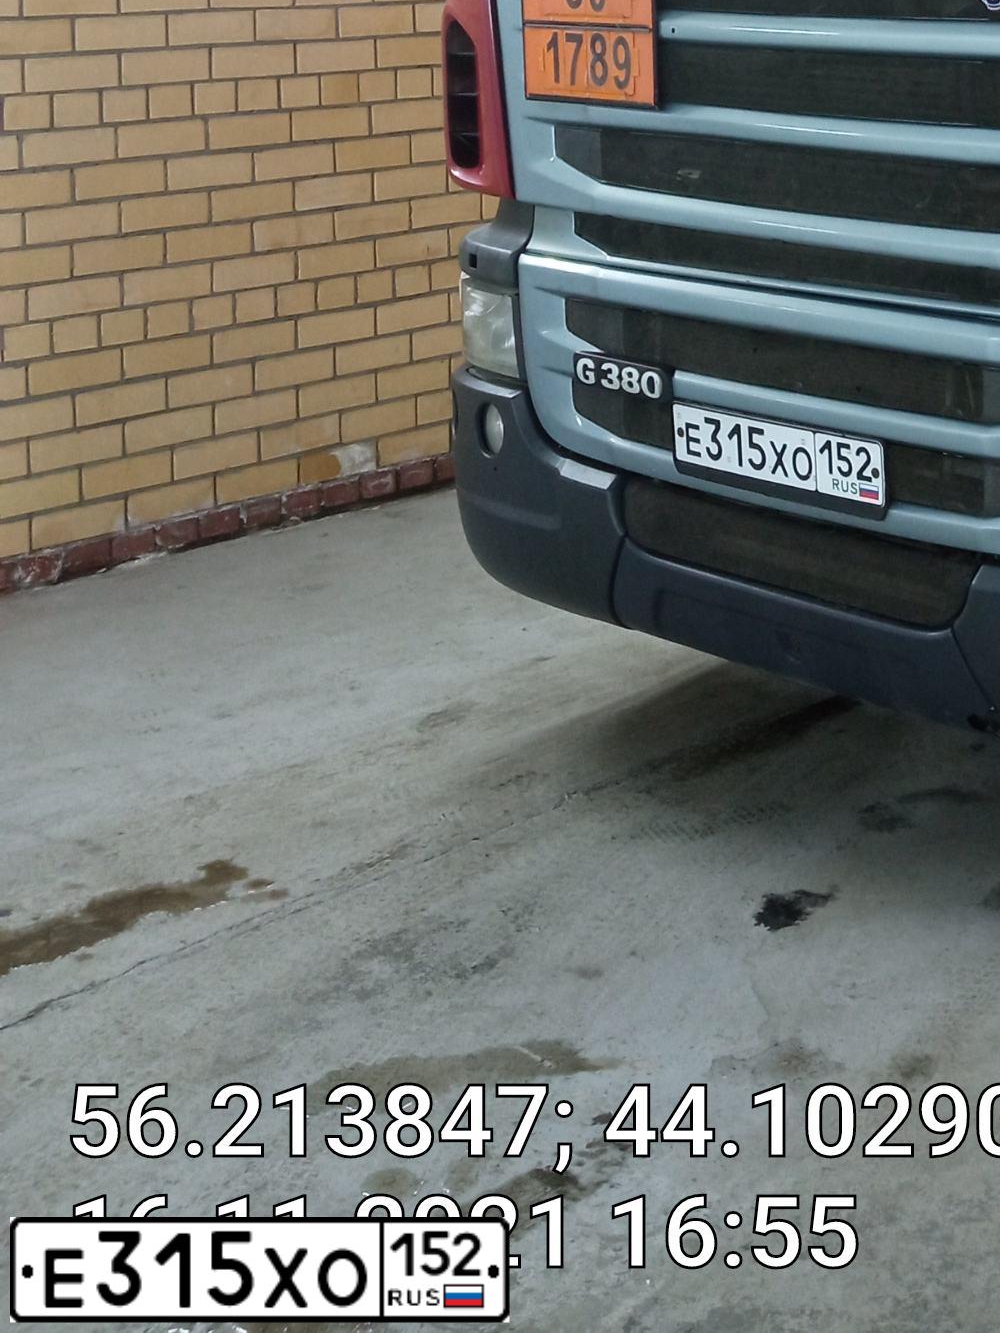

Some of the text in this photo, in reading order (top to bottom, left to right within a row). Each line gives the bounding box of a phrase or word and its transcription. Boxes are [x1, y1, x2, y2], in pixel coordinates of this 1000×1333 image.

[545, 31, 632, 91] 1789
[818, 440, 873, 483] 152
[831, 477, 858, 495] RUS
